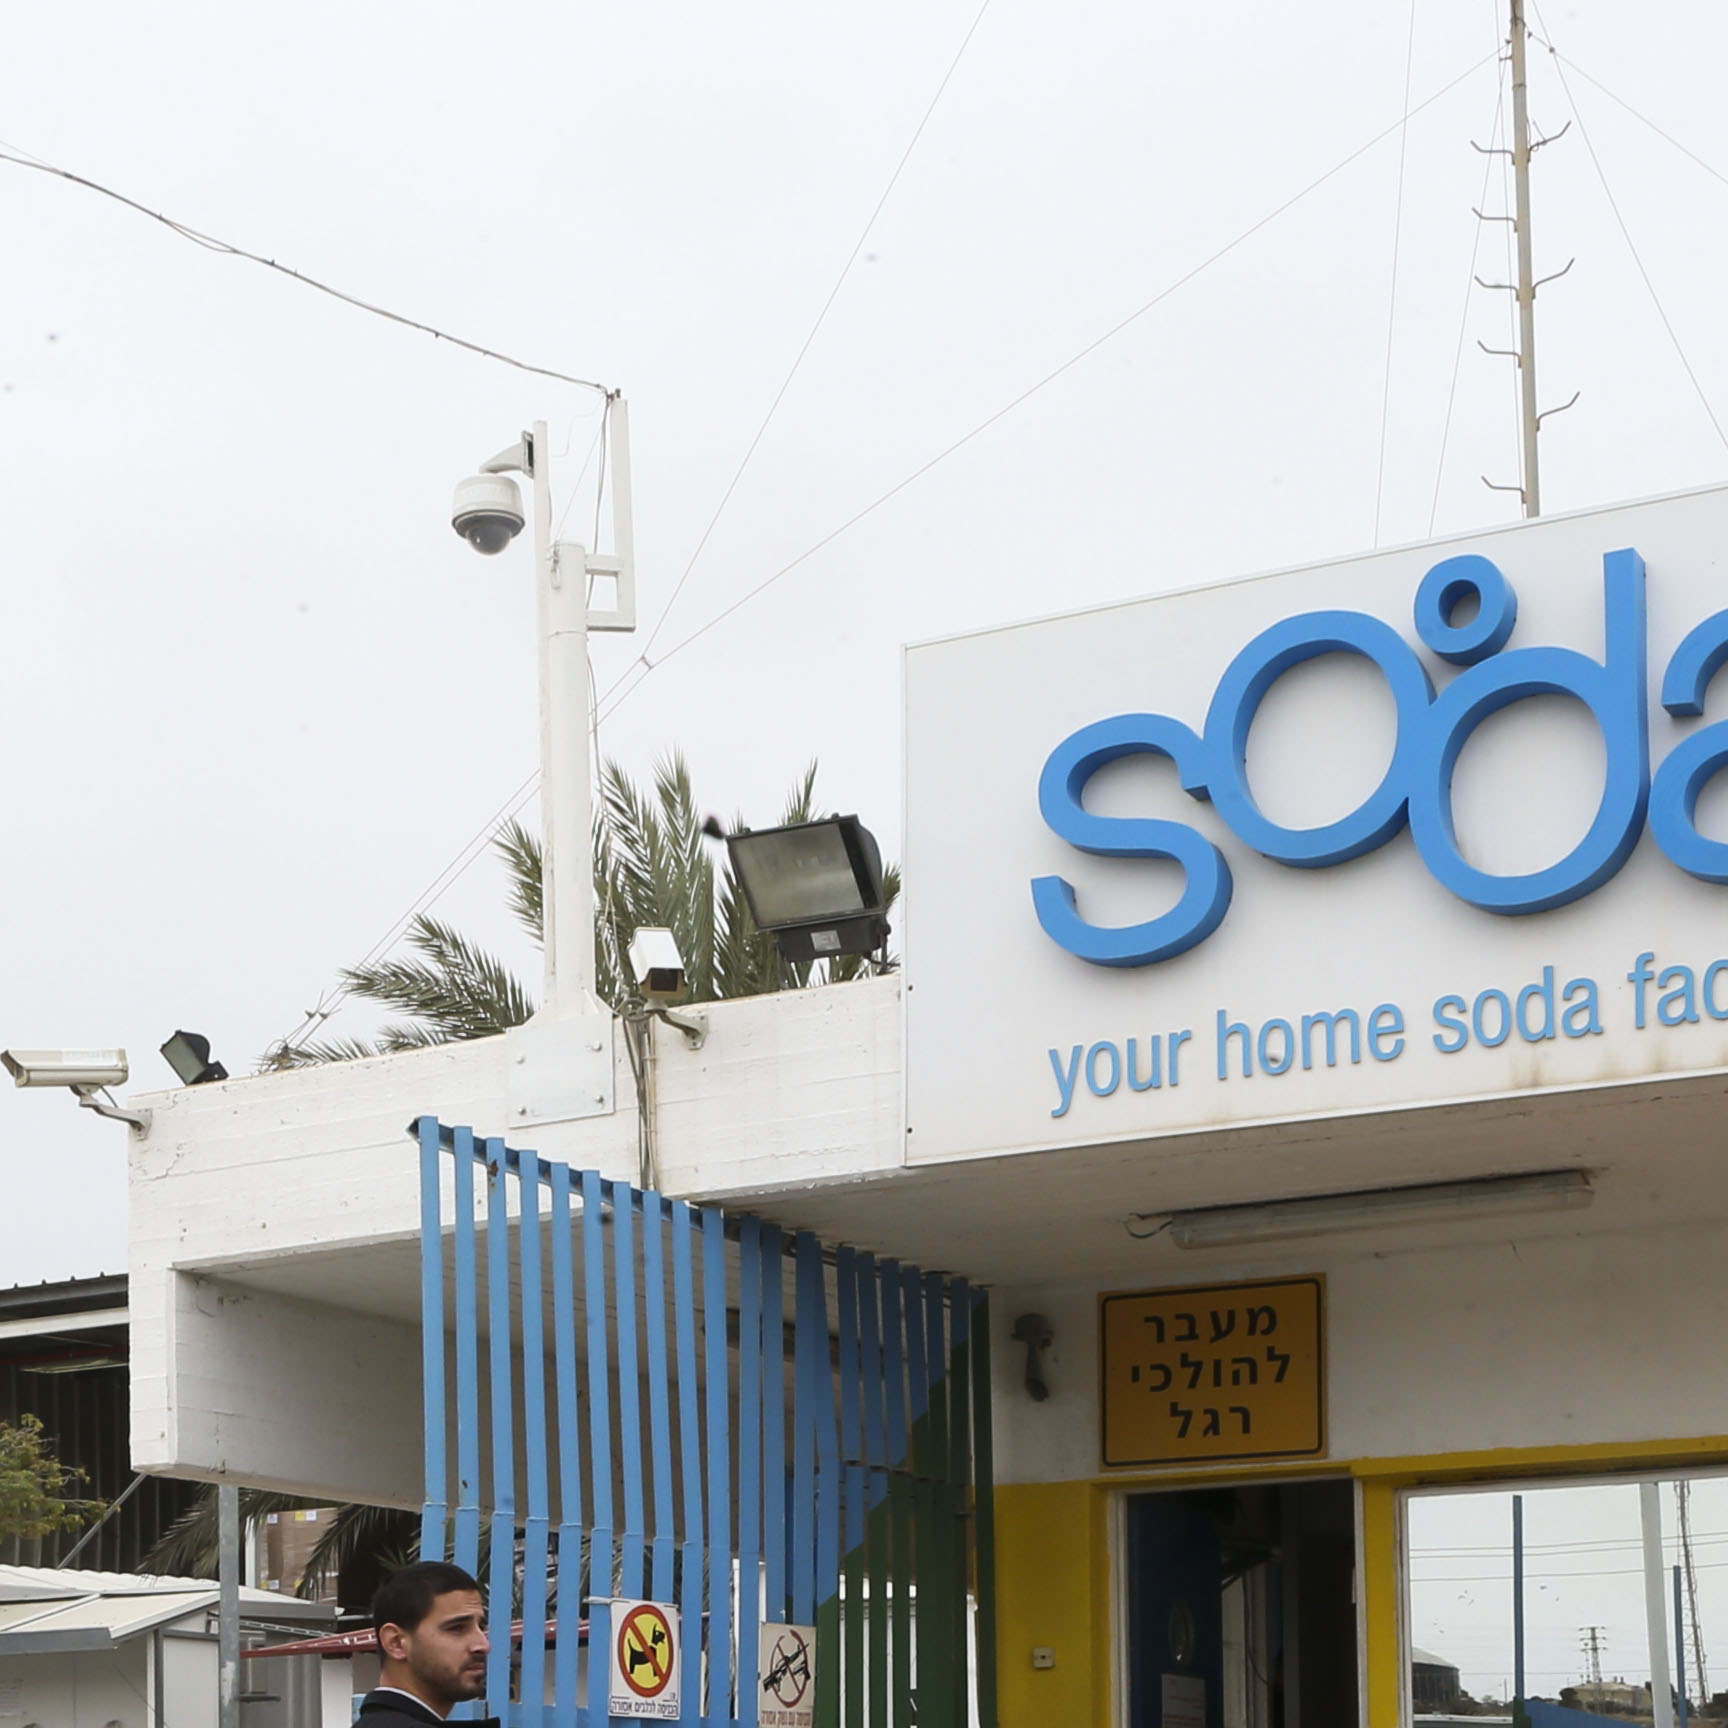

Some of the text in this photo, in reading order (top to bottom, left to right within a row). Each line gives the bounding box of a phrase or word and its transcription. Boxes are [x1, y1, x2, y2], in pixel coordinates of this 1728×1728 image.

[1049, 1030, 1191, 1118] your
[1216, 1009, 1405, 1080] home
[1432, 965, 1603, 1052] soda
[1143, 1305, 1278, 1344] מעבר
[1131, 1346, 1291, 1392] להולכי
[1169, 1401, 1251, 1439] רגל
